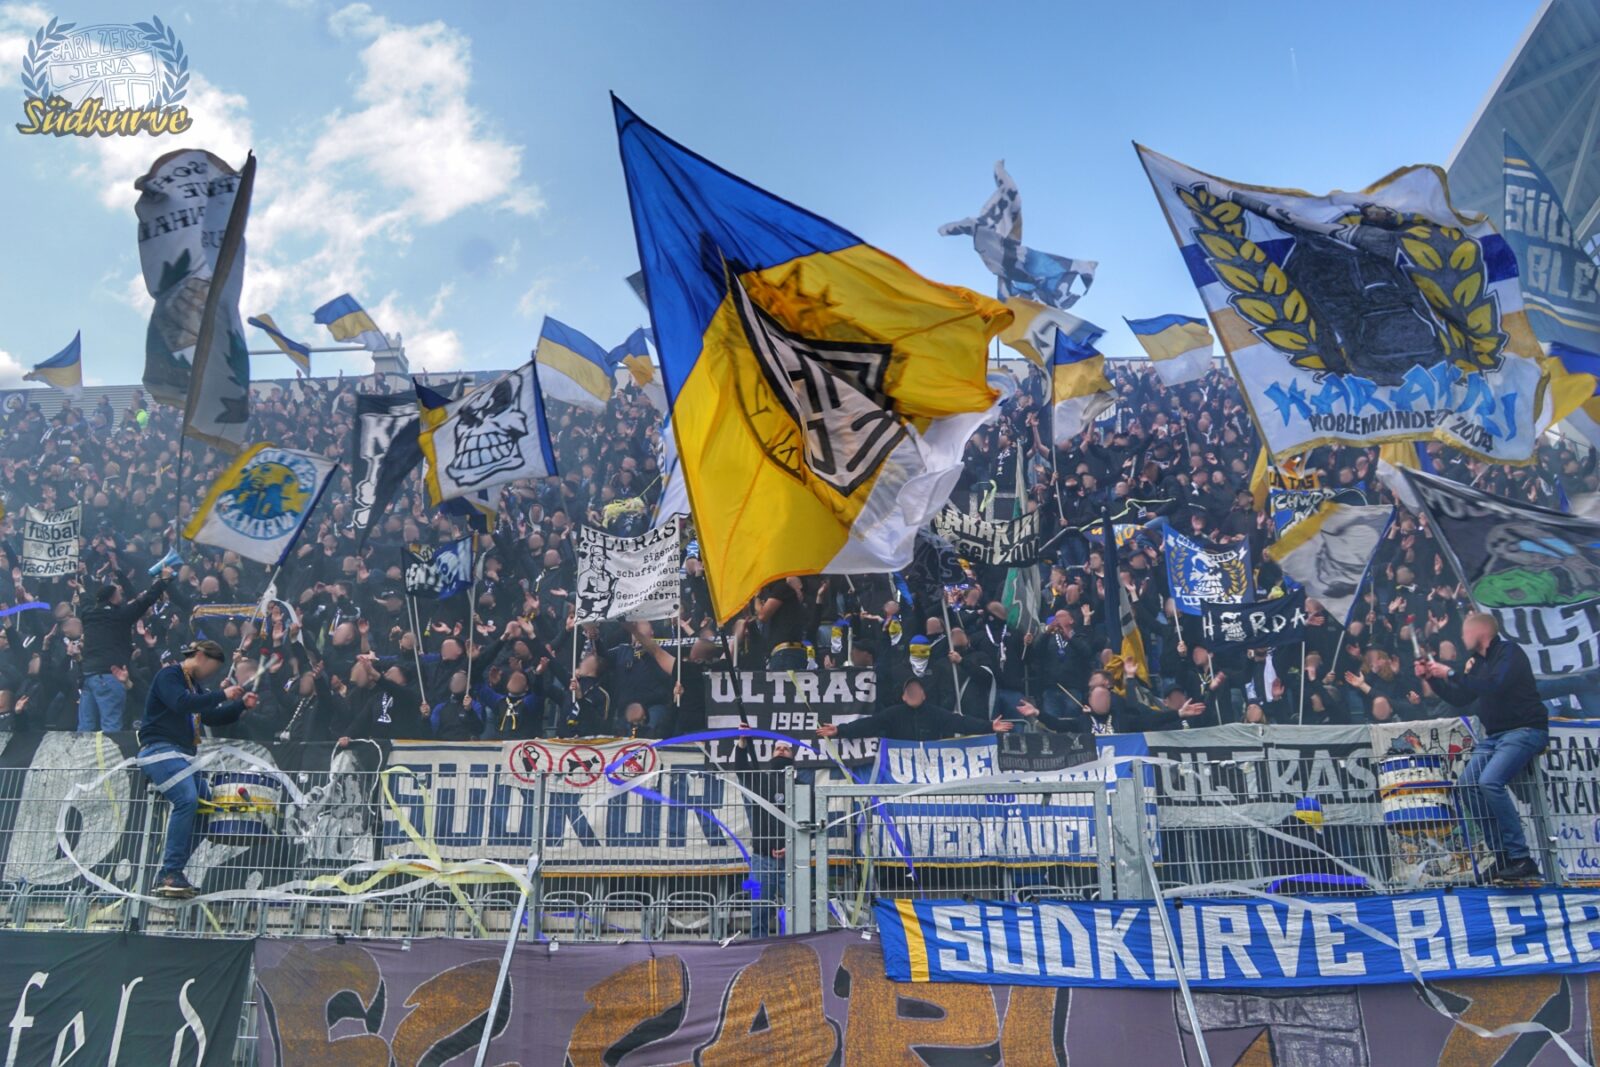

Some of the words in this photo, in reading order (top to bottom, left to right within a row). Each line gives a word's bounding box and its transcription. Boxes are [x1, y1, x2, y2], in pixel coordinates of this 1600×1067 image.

[584, 519, 677, 561] ULTRAS
[643, 541, 680, 564] Eigenes
[709, 671, 877, 703] ULTRAS
[770, 712, 818, 731] 1993
[709, 737, 879, 763] LAUANNE
[1157, 745, 1378, 803] ULTRAS
[382, 763, 852, 848] SÜDKUR
[932, 902, 1367, 981] SÜDKURVE
[1221, 997, 1313, 1025] JENA
